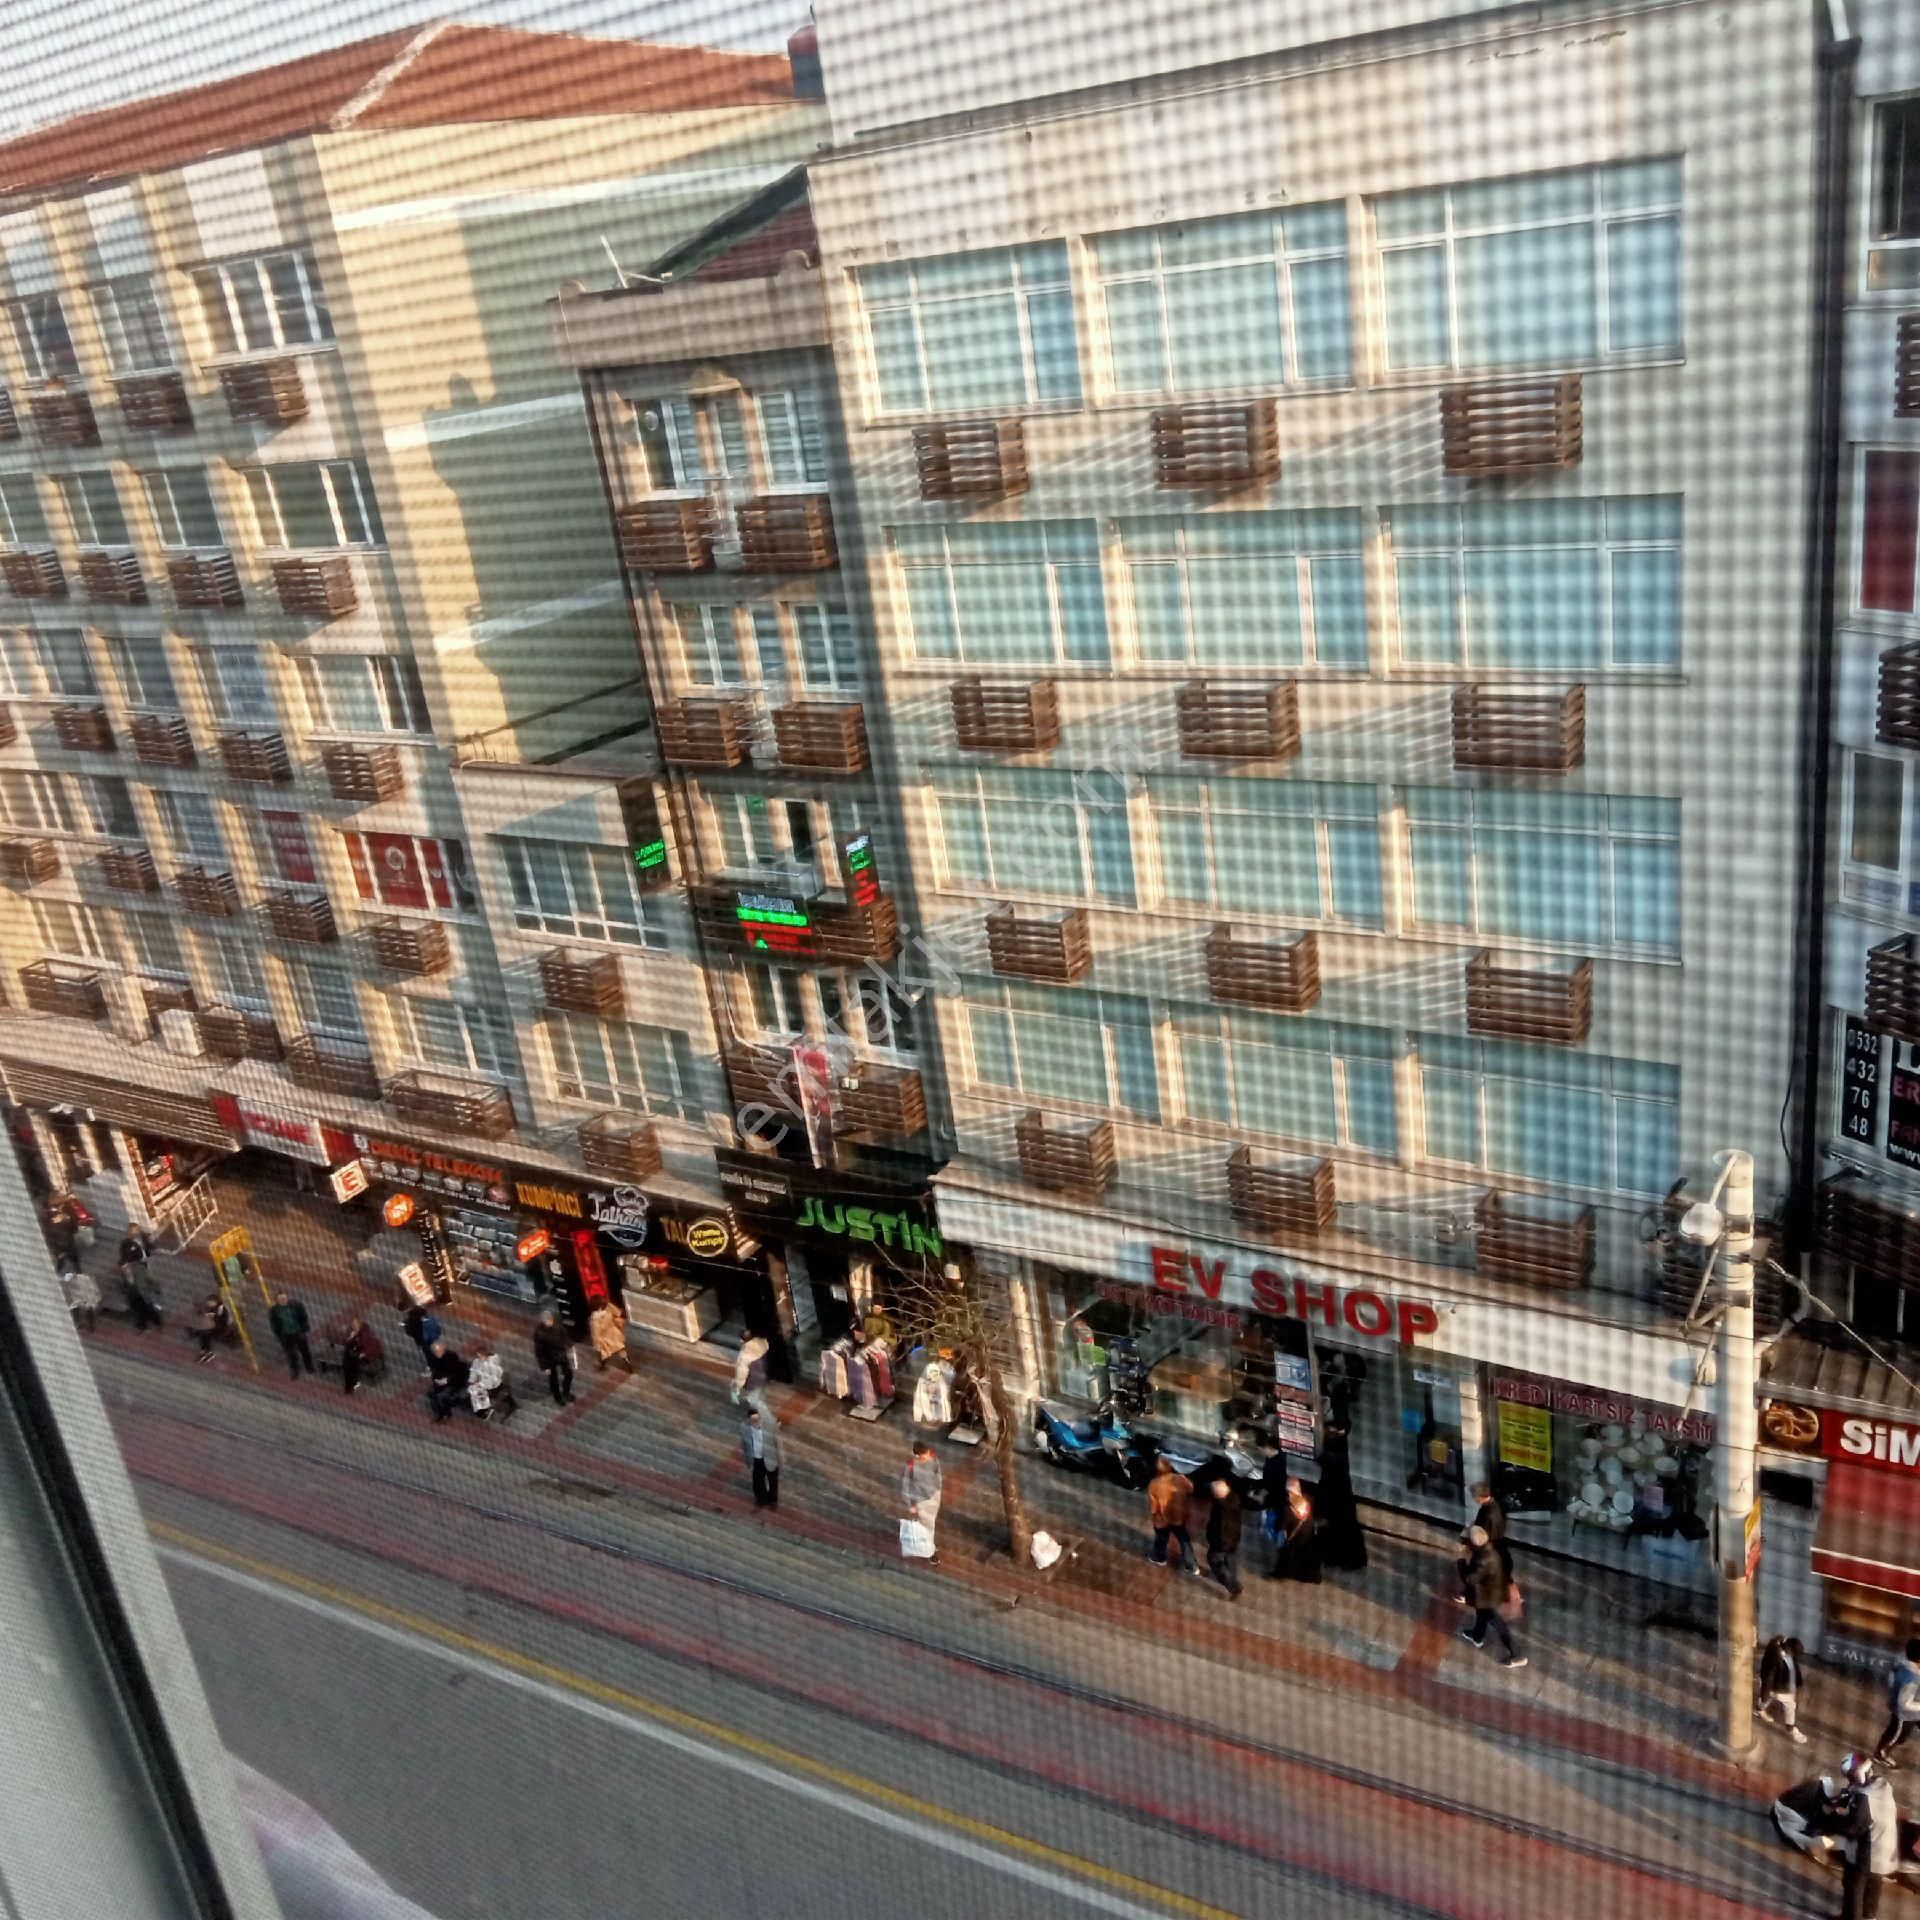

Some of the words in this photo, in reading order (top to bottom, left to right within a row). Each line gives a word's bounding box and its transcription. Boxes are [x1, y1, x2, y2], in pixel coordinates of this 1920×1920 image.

[1847, 1029, 1877, 1055] 0532
[1846, 1058, 1875, 1082] 432
[1850, 1086, 1870, 1109] 76
[1849, 1115, 1868, 1136] 48
[1151, 1246, 1226, 1299] EV
[1251, 1269, 1439, 1345] SHOP
